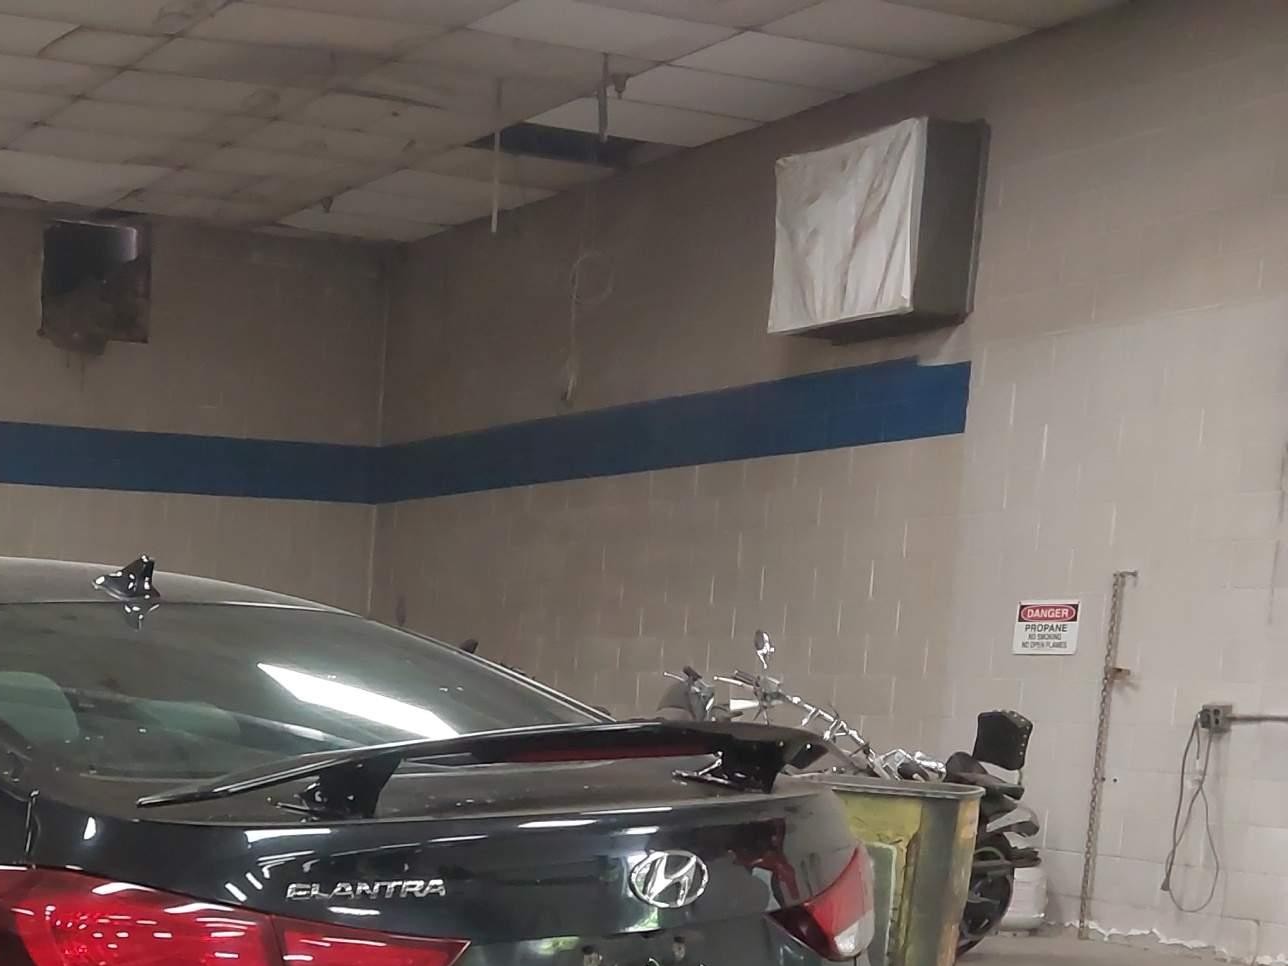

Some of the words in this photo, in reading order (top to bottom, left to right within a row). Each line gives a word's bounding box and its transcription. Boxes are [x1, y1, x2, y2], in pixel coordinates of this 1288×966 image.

[1027, 608, 1069, 618] DANGER
[1024, 623, 1068, 632] PROPANE
[285, 878, 447, 901] ELANTRA
